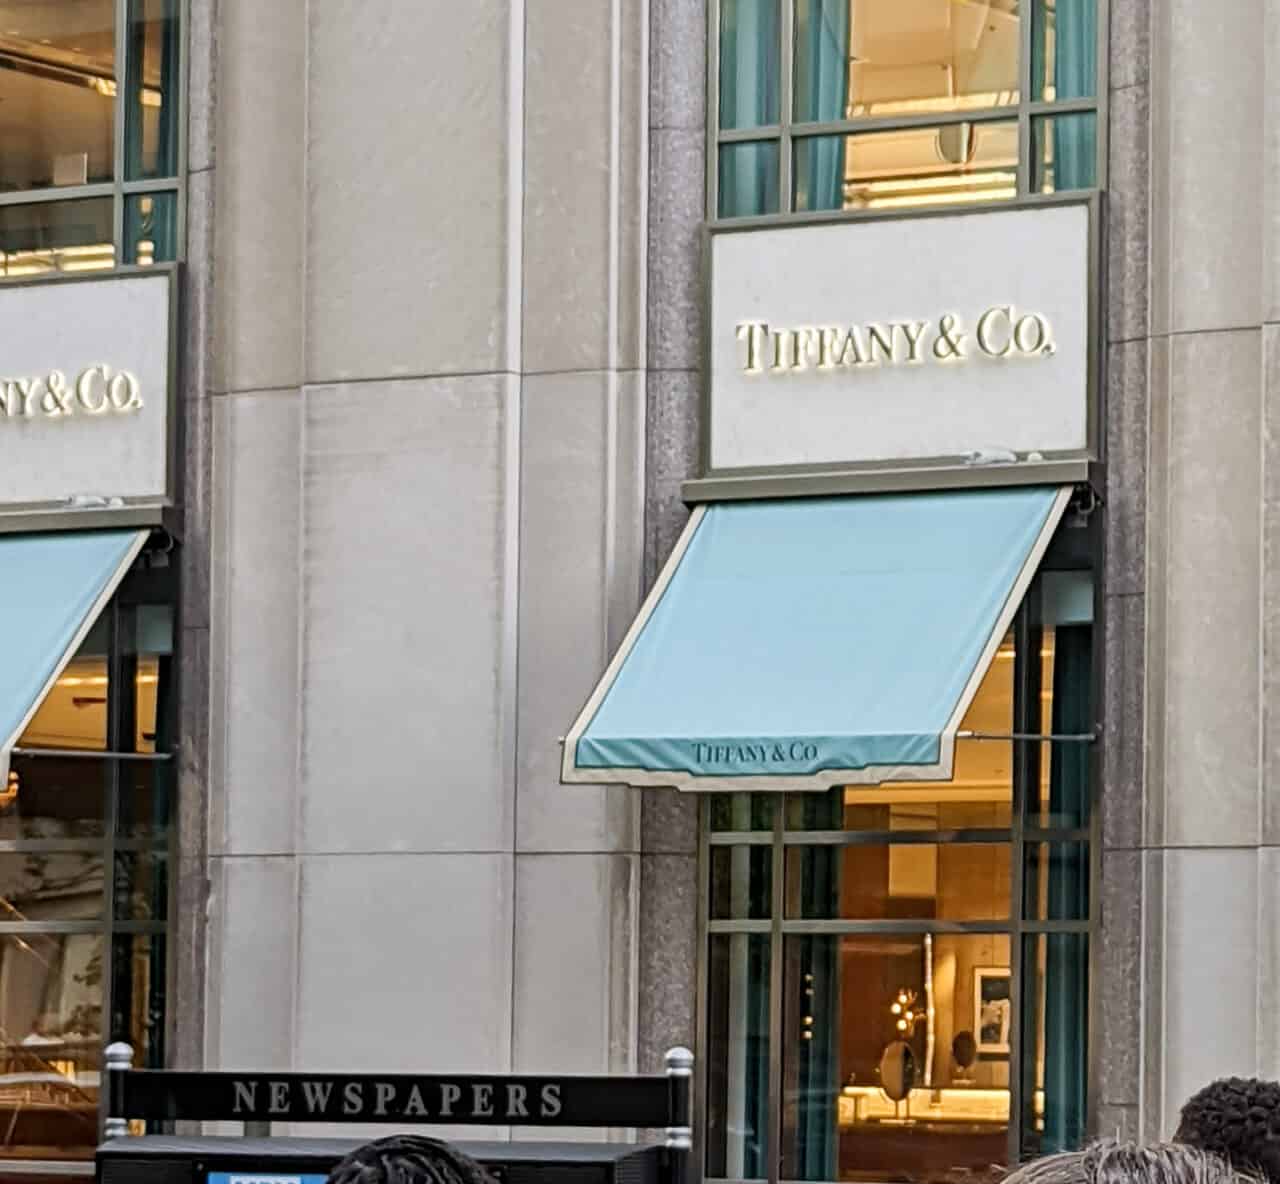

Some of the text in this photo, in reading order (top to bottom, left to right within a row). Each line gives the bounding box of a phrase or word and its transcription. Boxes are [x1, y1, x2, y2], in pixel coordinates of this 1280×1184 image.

[735, 319, 930, 373] TIFFANY
[932, 313, 967, 361] &
[691, 742, 768, 764] TIFFANY
[232, 1080, 562, 1117] NEWSPAPERS
